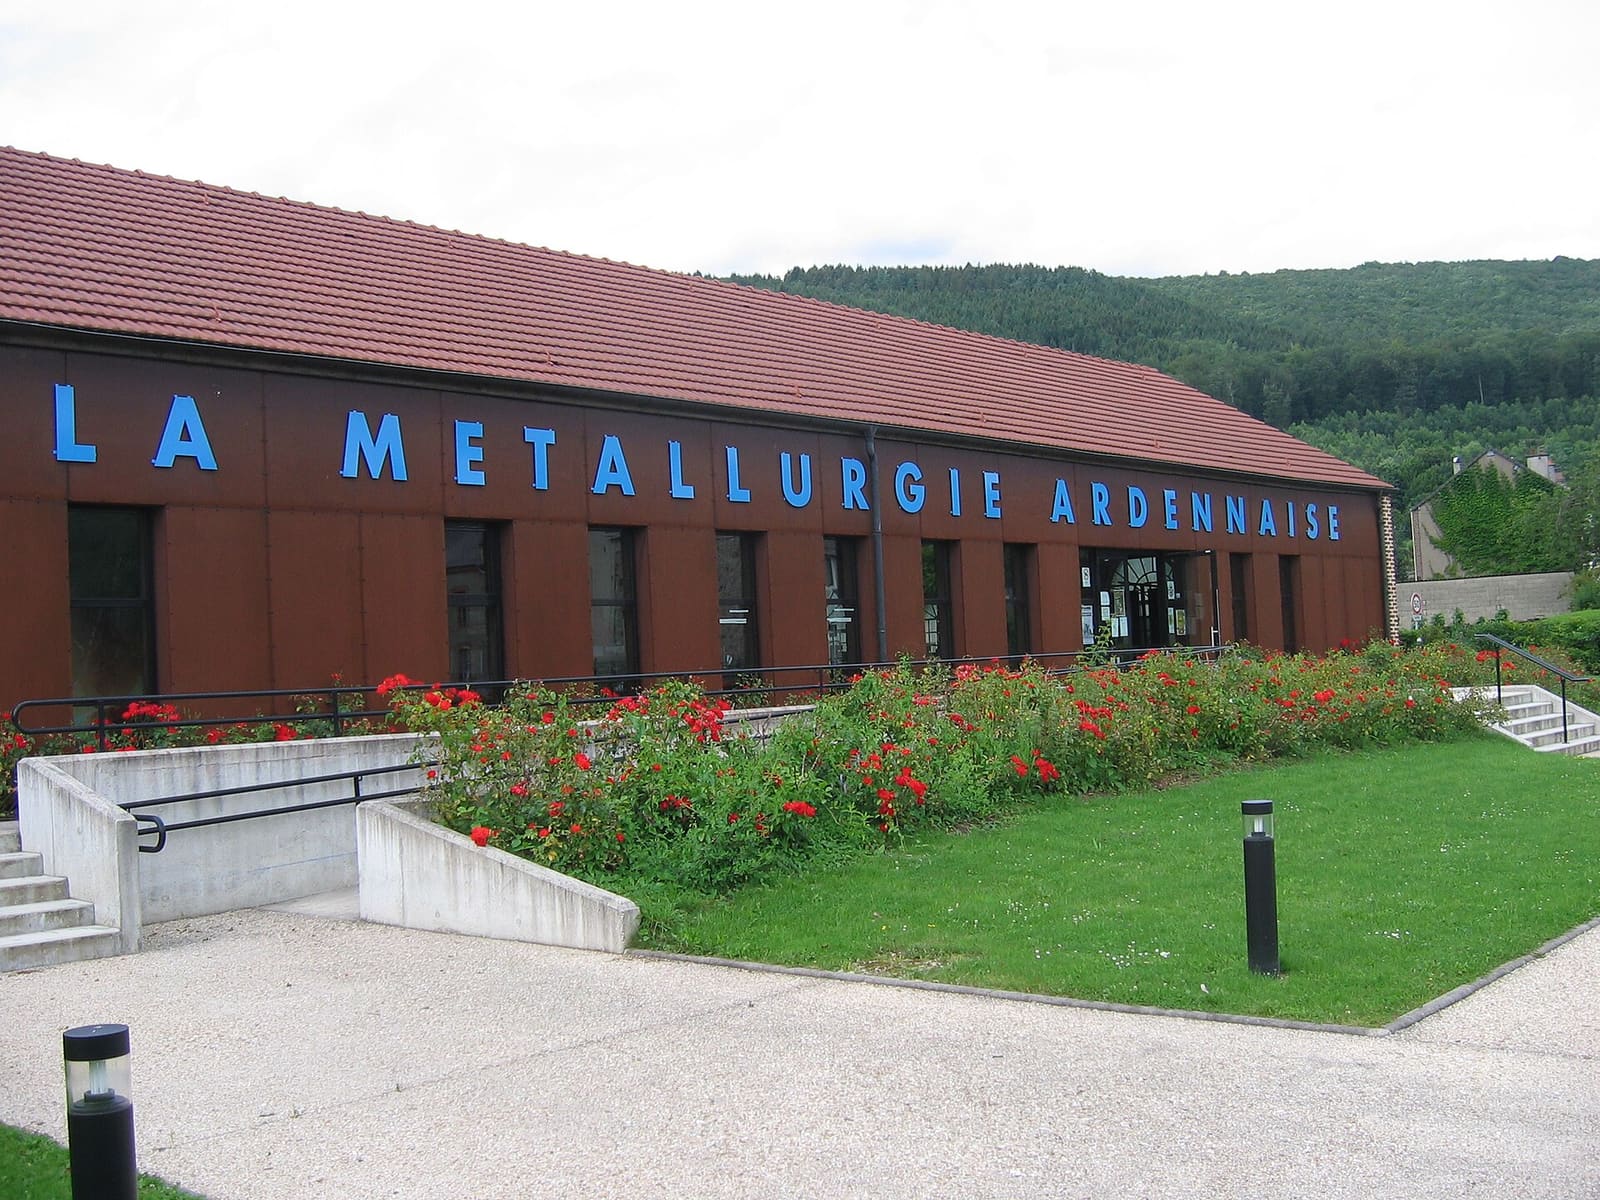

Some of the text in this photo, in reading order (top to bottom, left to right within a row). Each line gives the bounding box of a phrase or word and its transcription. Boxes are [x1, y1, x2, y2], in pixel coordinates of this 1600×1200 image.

[53, 383, 1341, 542] LA METALLURGIE ARDENNAISE
